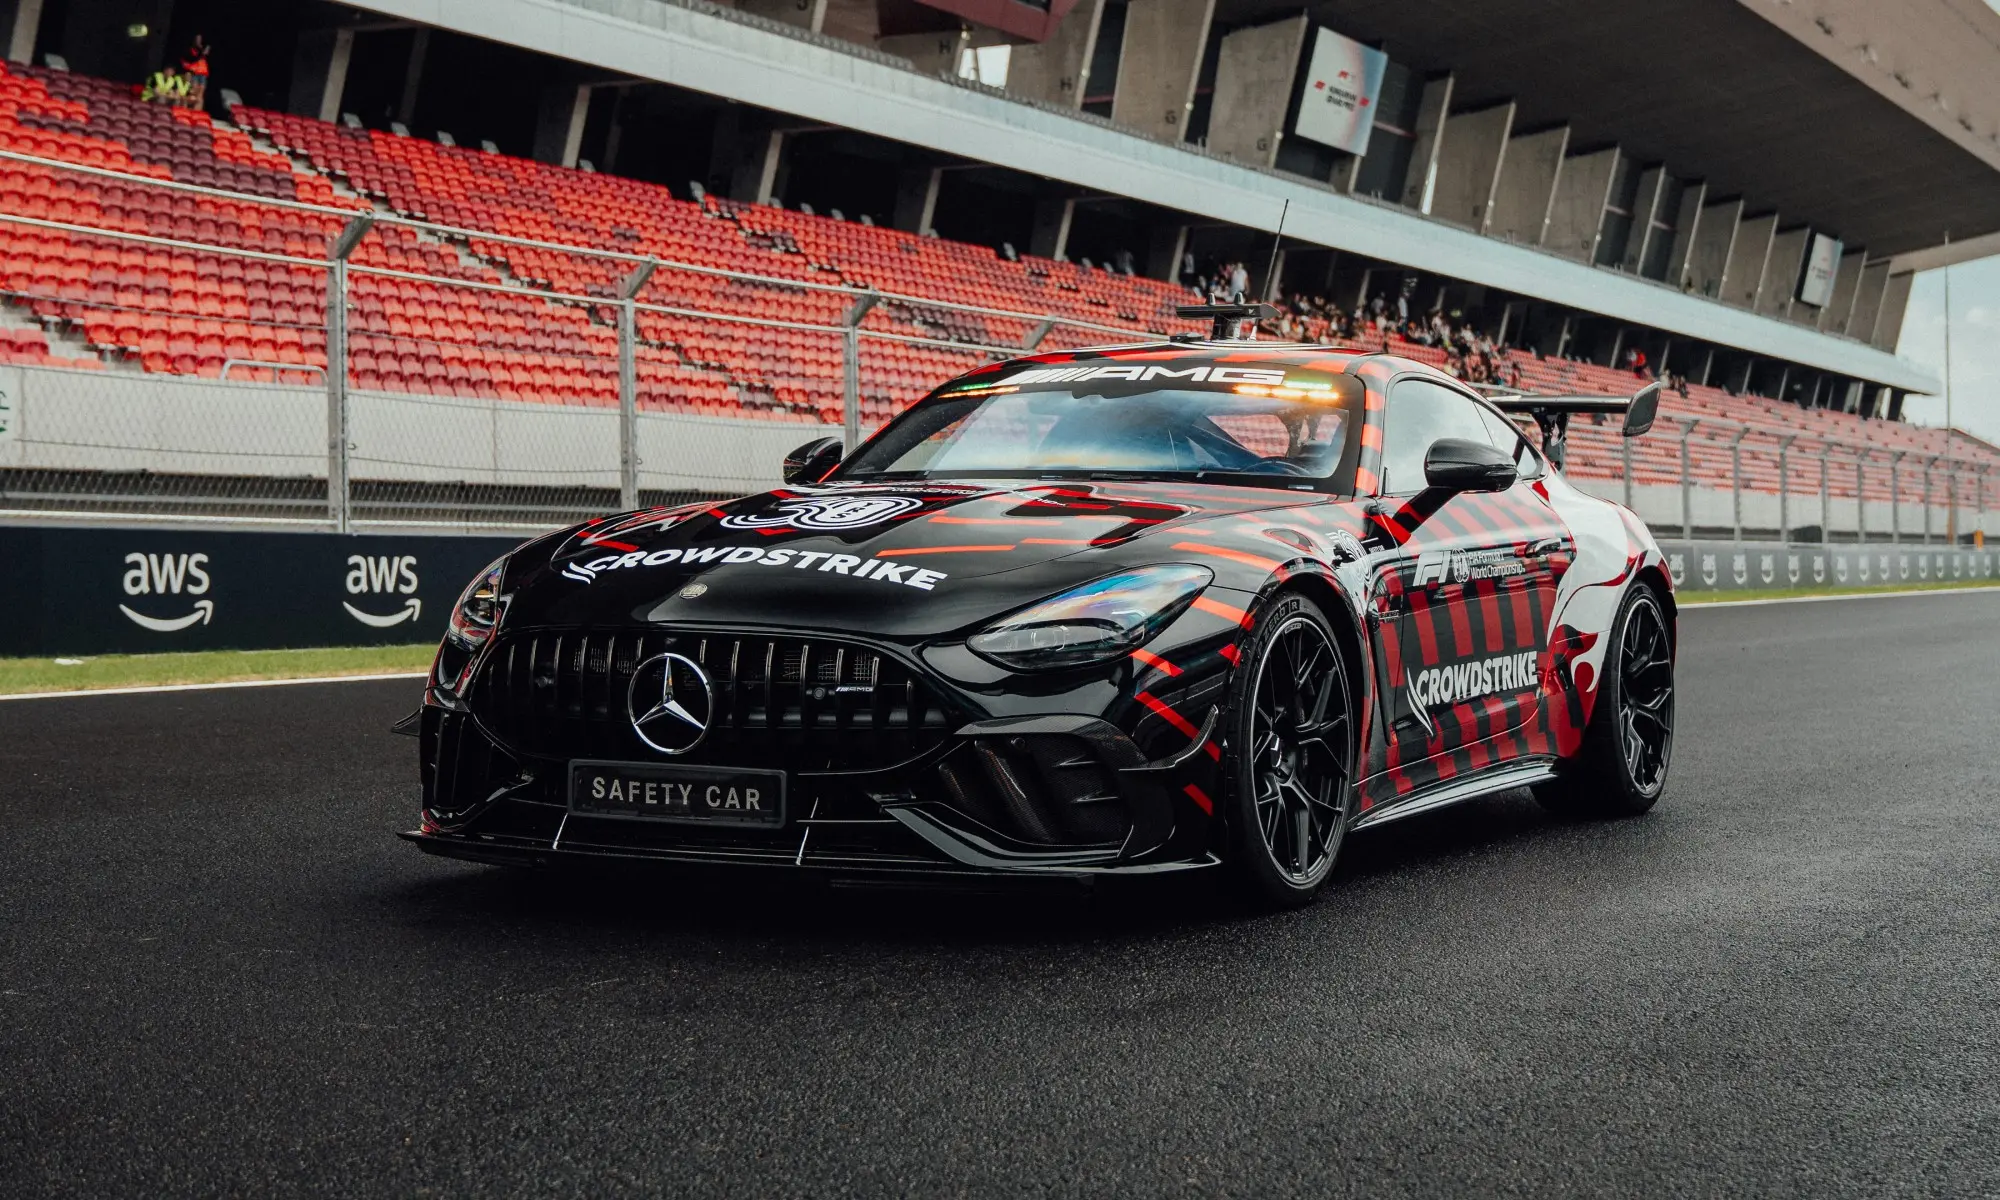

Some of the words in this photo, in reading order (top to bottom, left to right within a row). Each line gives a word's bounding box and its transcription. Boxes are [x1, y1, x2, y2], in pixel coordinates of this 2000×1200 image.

[1060, 76, 1072, 91] H
[123, 552, 210, 595] aws
[346, 555, 418, 594] aws
[589, 546, 948, 590] CROWDSTRIKE
[1471, 565, 1487, 580] World
[1416, 651, 1539, 706] CROWDSTRIKE
[592, 777, 693, 805] SAFETY
[705, 785, 760, 810] CAR
